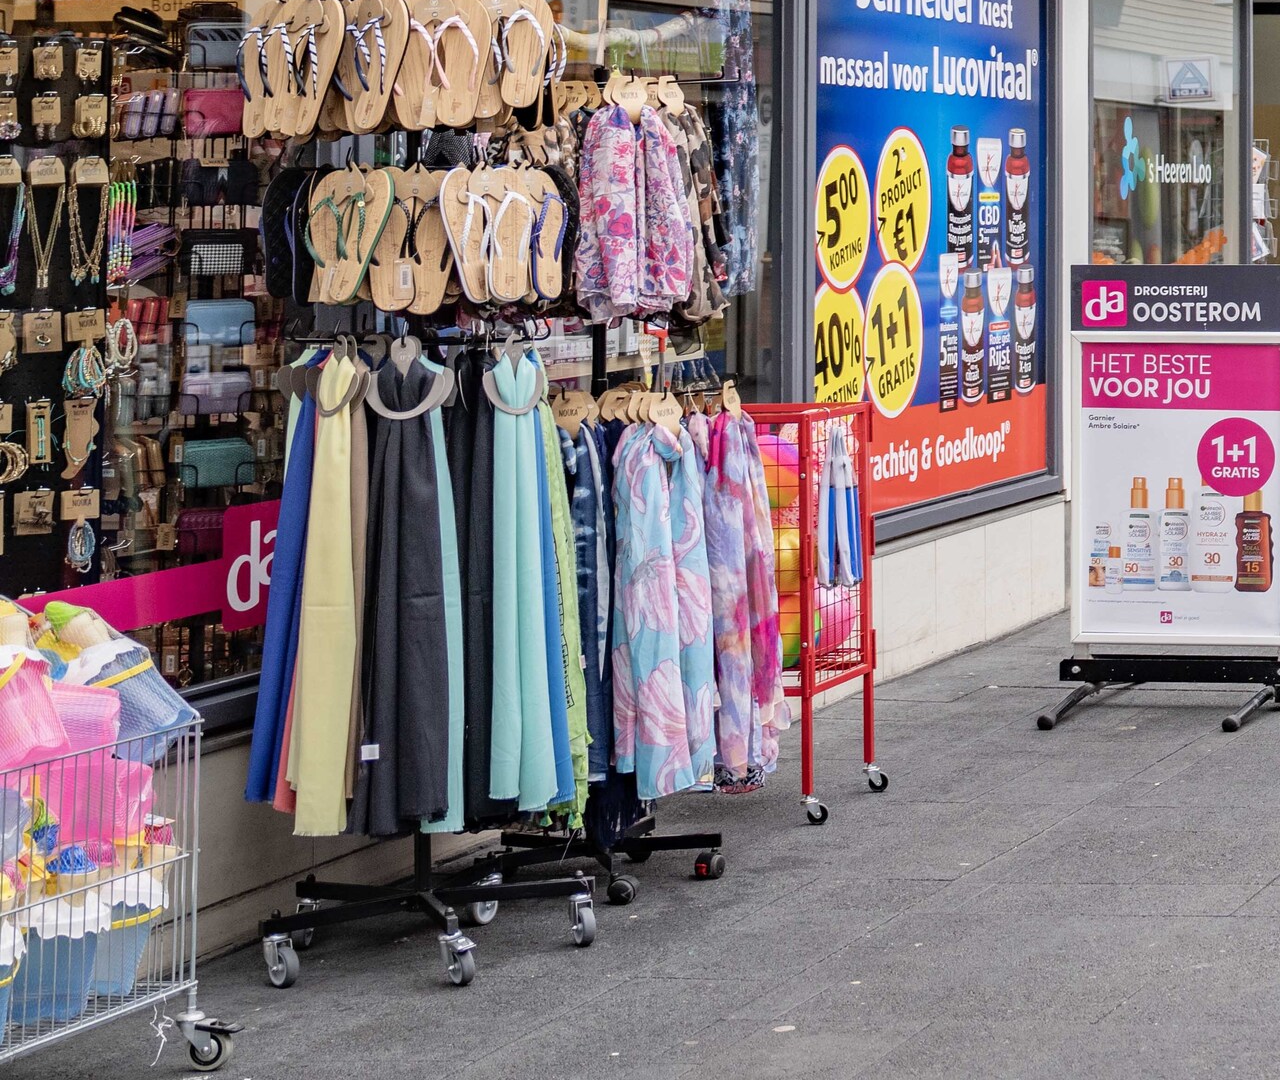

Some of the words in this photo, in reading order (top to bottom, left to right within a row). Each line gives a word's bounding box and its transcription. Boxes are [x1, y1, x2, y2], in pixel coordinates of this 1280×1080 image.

[820, 51, 889, 89] massaal
[892, 63, 929, 92] voor
[1156, 154, 1191, 184] Heeren
[1193, 155, 1211, 184] Loo
[881, 168, 922, 212] PRODUCT
[979, 205, 1000, 225] CBD
[893, 202, 918, 261] €1
[979, 228, 984, 244] 5
[829, 237, 863, 271] KORTING
[1085, 286, 1125, 320] da
[1134, 286, 1208, 298] DROGISTERIJ
[1133, 302, 1261, 322] OOSTEROM
[872, 286, 911, 367] 1+1
[814, 313, 861, 386] 40%
[940, 335, 947, 366] 5
[989, 334, 1001, 345] Rode
[1001, 333, 1010, 346] gist
[1015, 341, 1036, 354] Cranberry
[947, 353, 958, 368] mg
[989, 345, 1010, 371] Rijst
[1090, 353, 1135, 373] HET
[1143, 354, 1212, 375] BESTE
[879, 353, 915, 399] GRATIS
[1089, 377, 1159, 398] VOOR
[1162, 378, 1211, 404] JOU
[558, 409, 578, 417] NOUKA
[921, 438, 932, 470] &
[1211, 435, 1257, 464] 1+1
[1211, 466, 1260, 478] GRATIS
[1125, 563, 1139, 573] 50
[1168, 556, 1183, 566] 30
[1204, 552, 1220, 564] 30
[1245, 561, 1260, 572] 15
